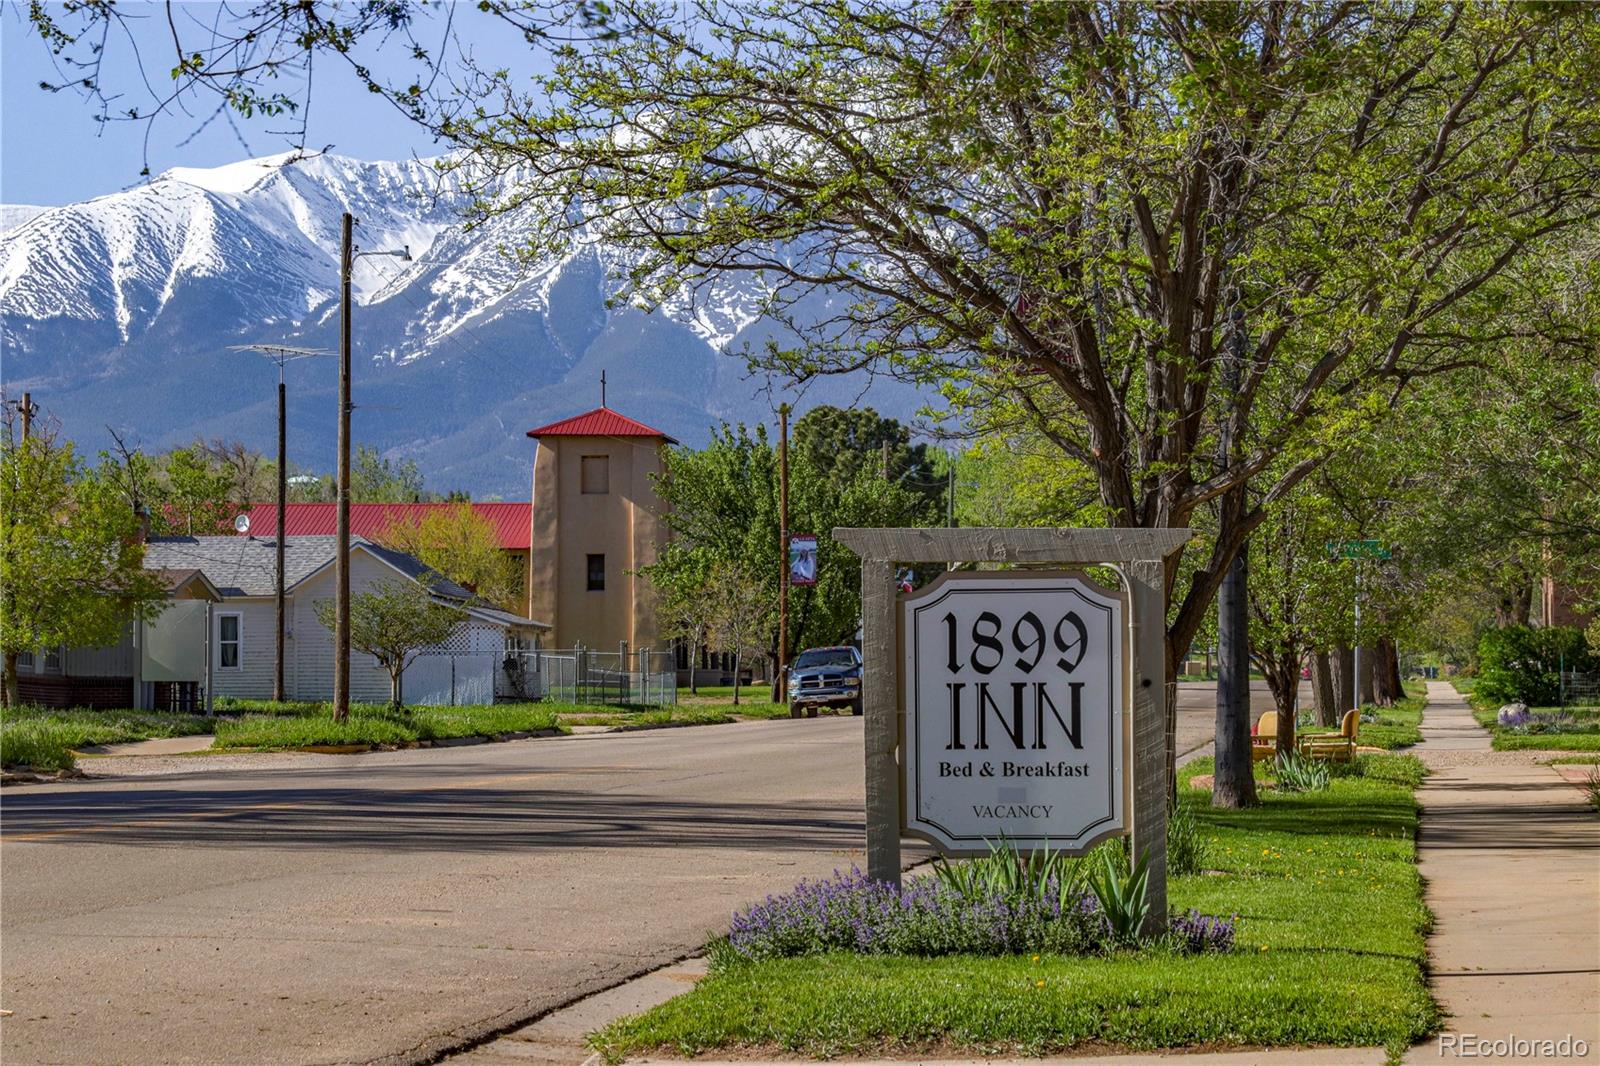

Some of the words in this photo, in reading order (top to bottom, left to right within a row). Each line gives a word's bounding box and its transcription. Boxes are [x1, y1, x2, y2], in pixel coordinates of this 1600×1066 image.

[941, 610, 1088, 675] 1899
[946, 682, 1086, 751] INN
[939, 761, 972, 778] Bed
[979, 761, 995, 778] &
[1003, 761, 1090, 778] Breakfast
[972, 804, 1054, 819] VACANCY
